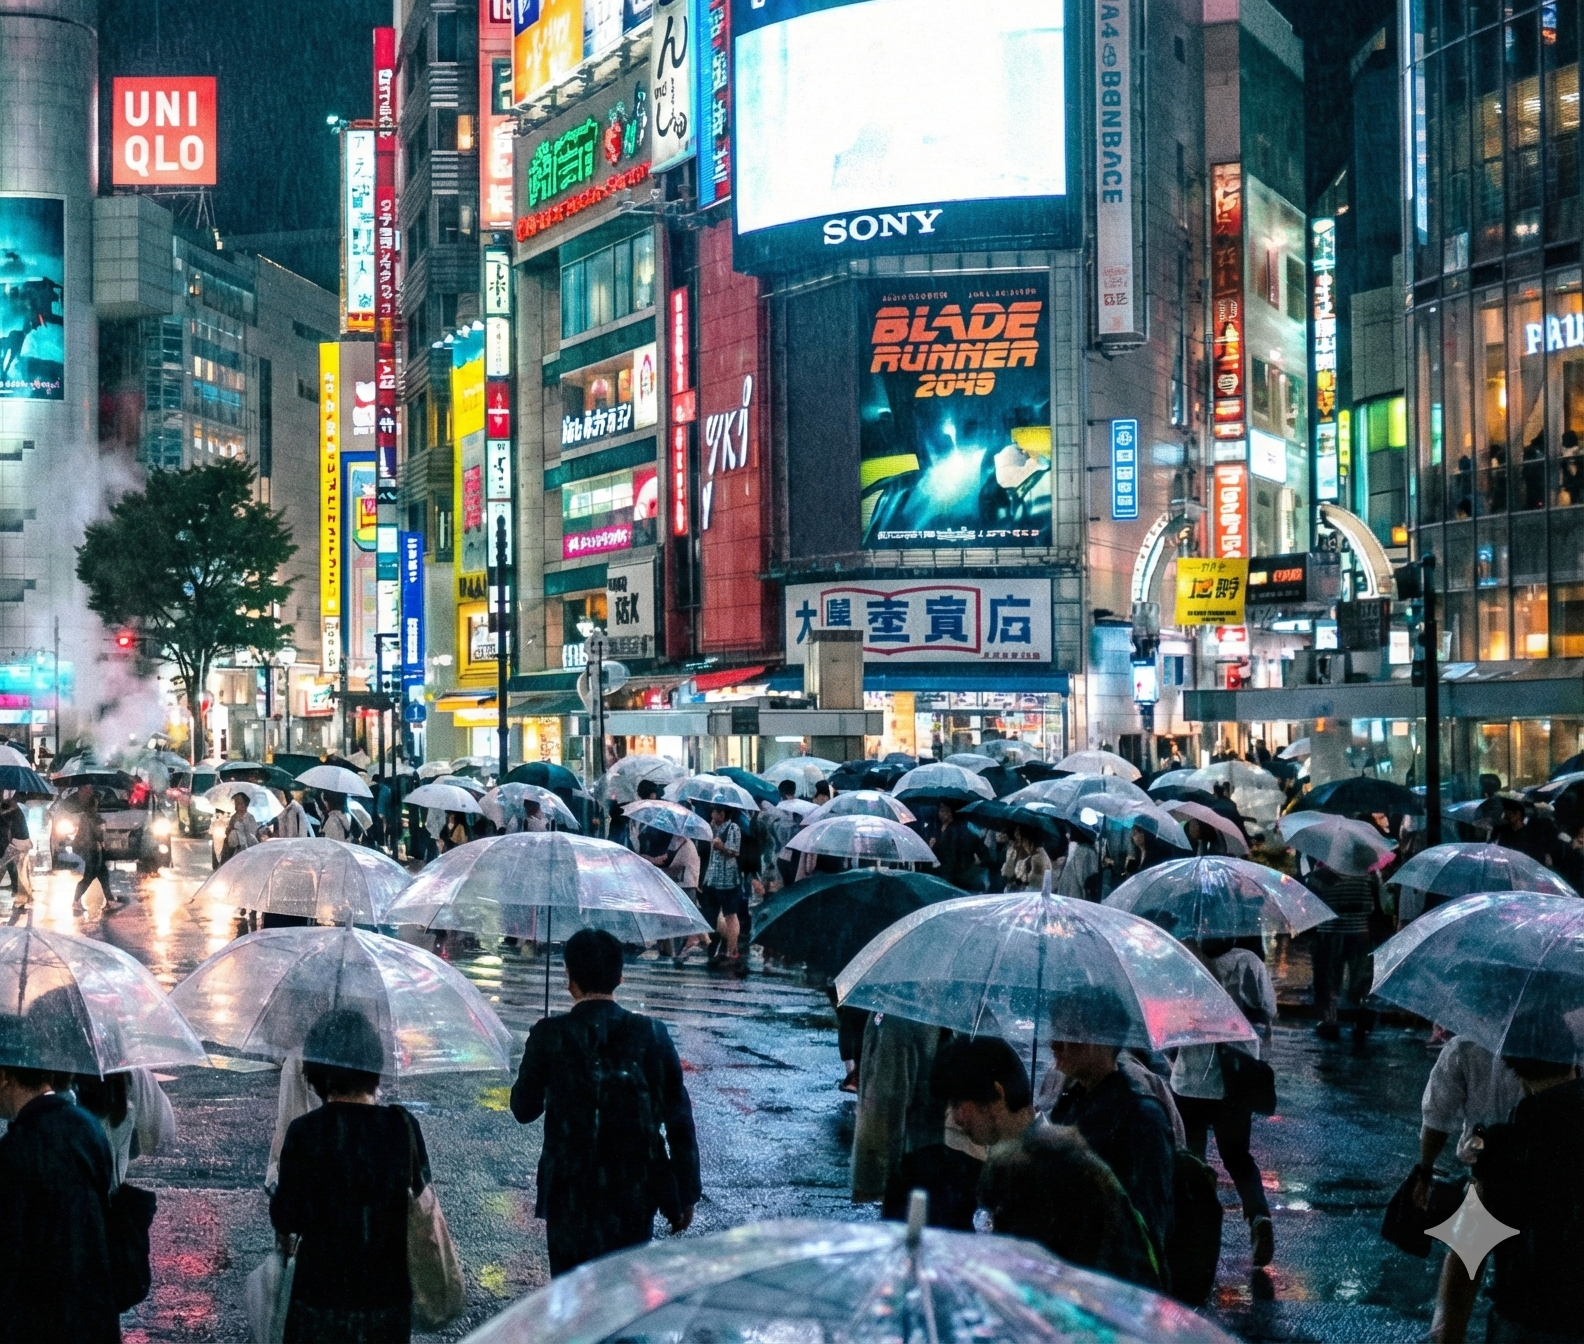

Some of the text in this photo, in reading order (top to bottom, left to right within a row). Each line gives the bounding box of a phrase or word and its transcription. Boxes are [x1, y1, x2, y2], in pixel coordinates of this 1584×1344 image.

[125, 91, 197, 127] UNI
[125, 135, 204, 177] QLO
[823, 209, 943, 245] SONY
[871, 301, 1042, 344] BLADE
[870, 340, 1039, 373] RUNNER
[914, 372, 996, 397] 2049
